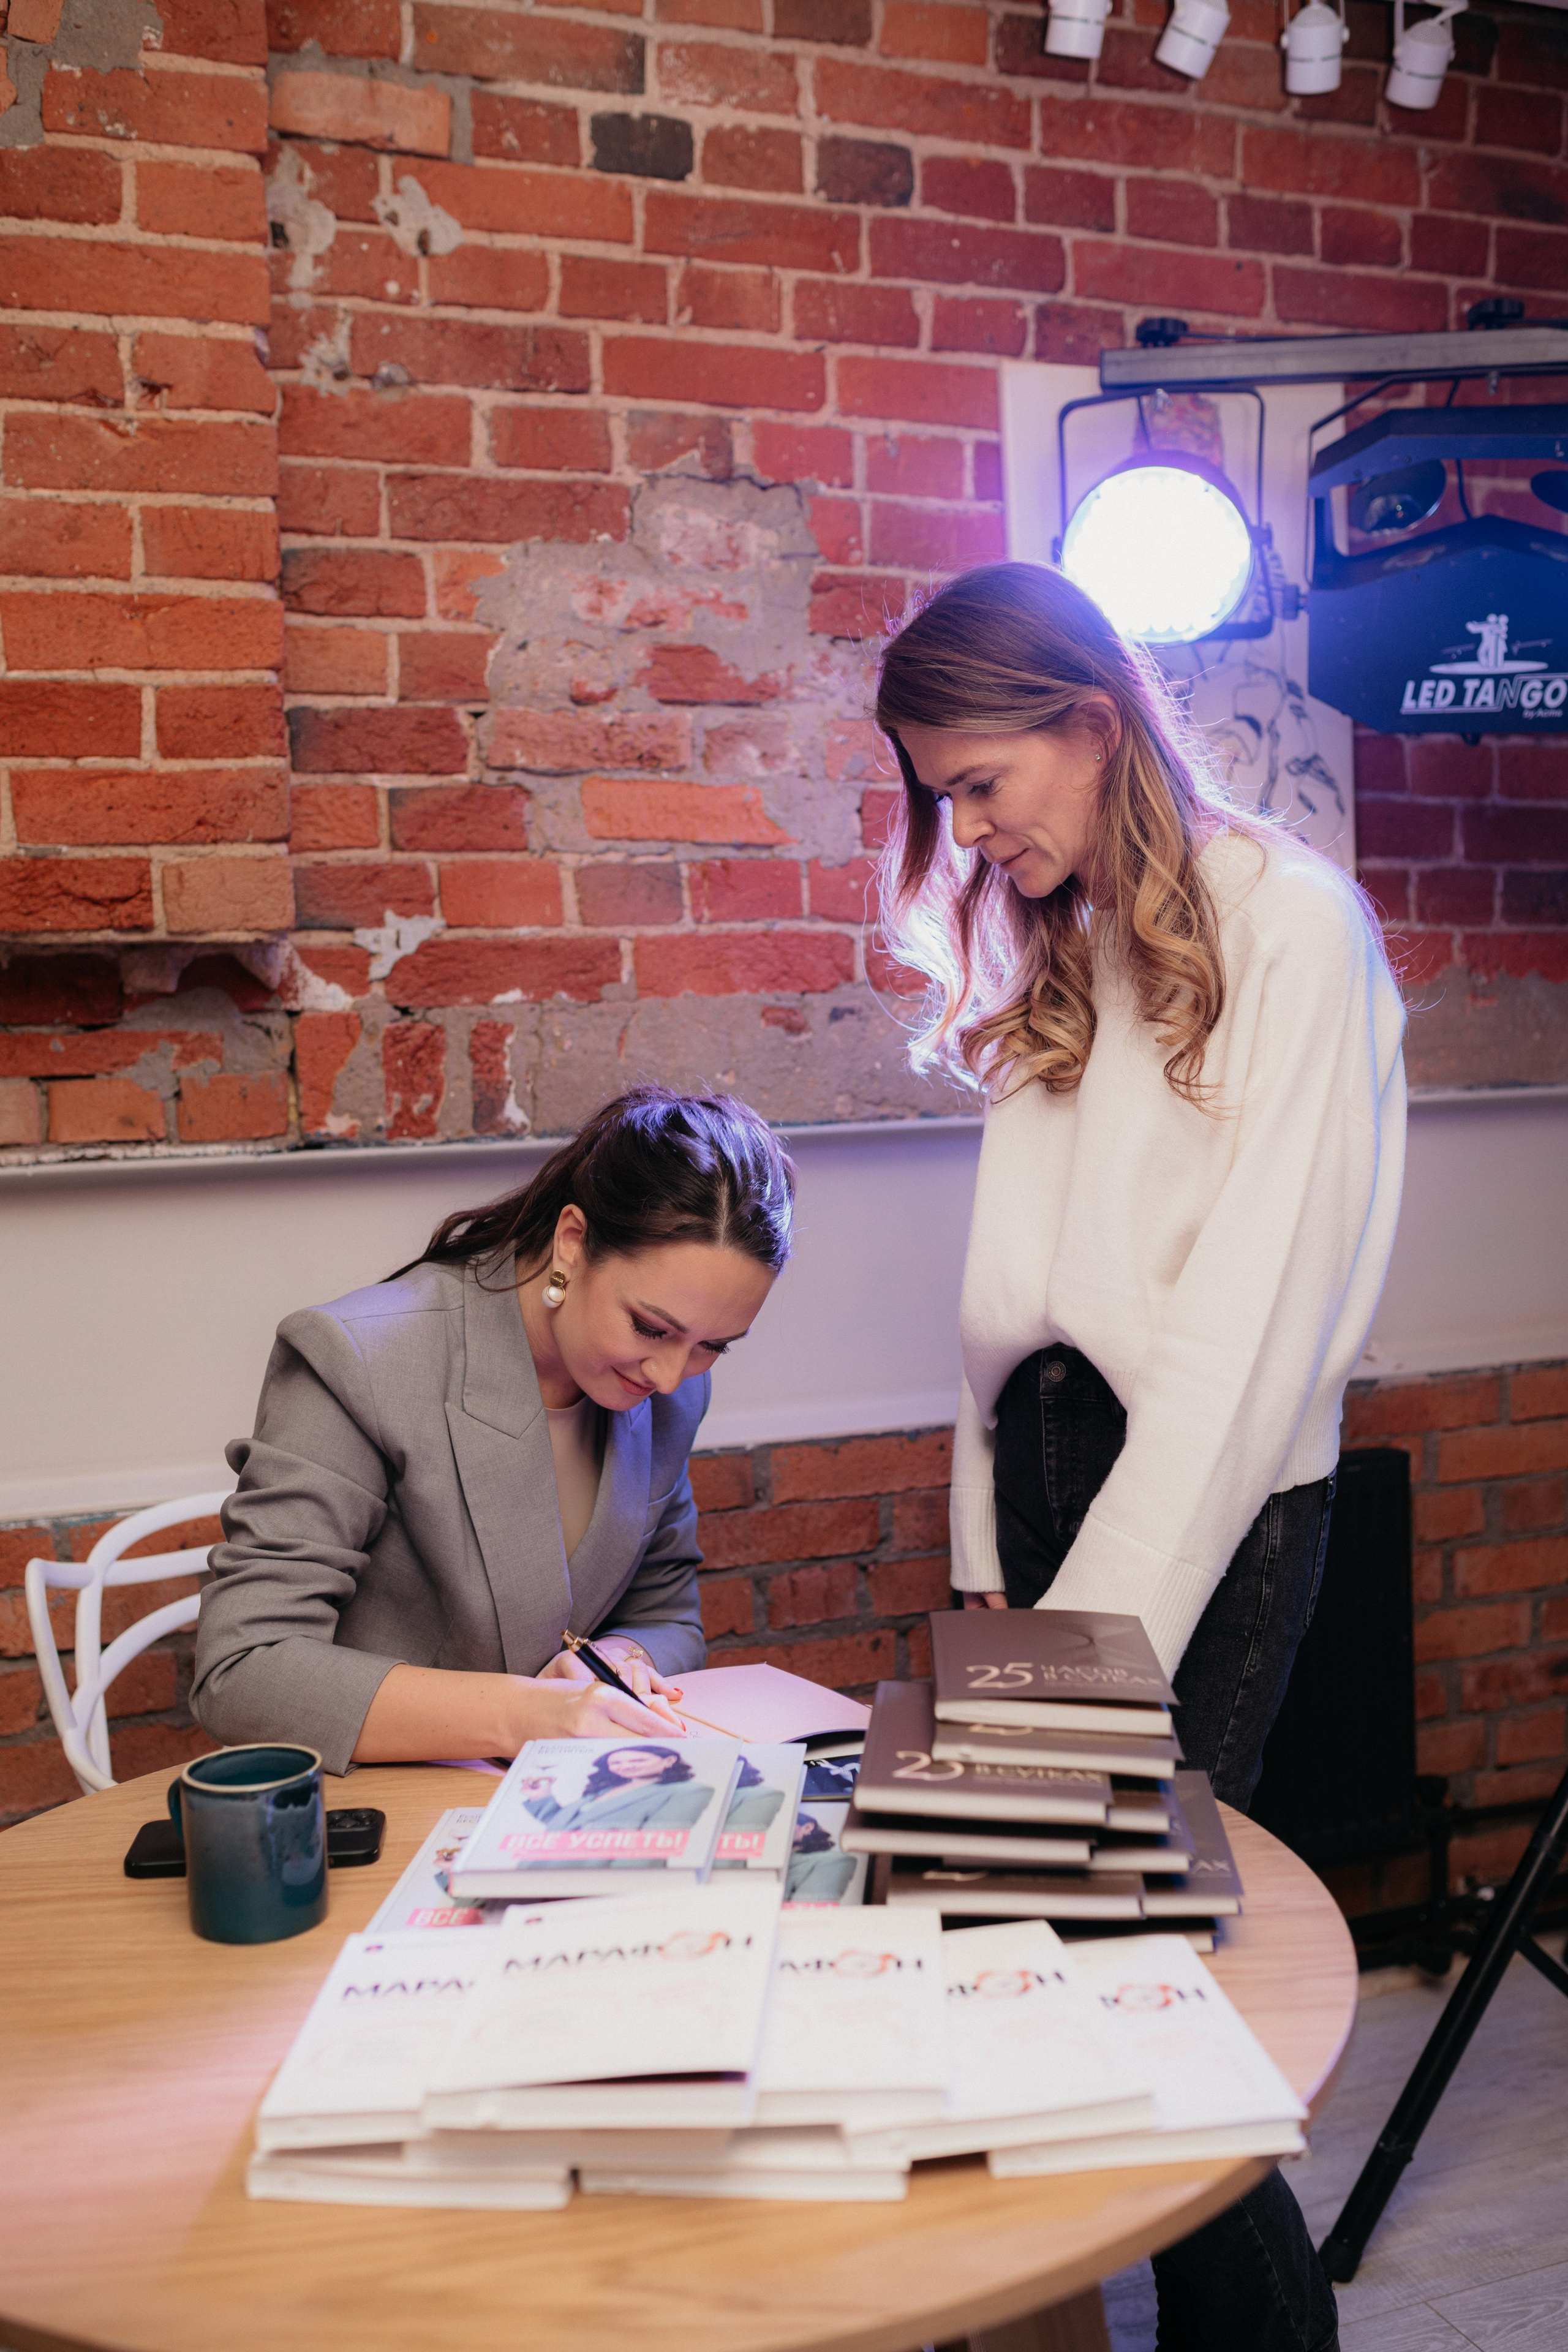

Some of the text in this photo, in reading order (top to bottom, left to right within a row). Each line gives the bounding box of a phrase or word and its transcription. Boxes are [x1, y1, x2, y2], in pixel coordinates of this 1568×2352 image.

[1402, 677, 1567, 709] LED TANGO
[966, 1662, 1034, 1688] 25
[503, 1931, 753, 1974] МАРАФОН
[341, 1977, 475, 2001] МАРА
